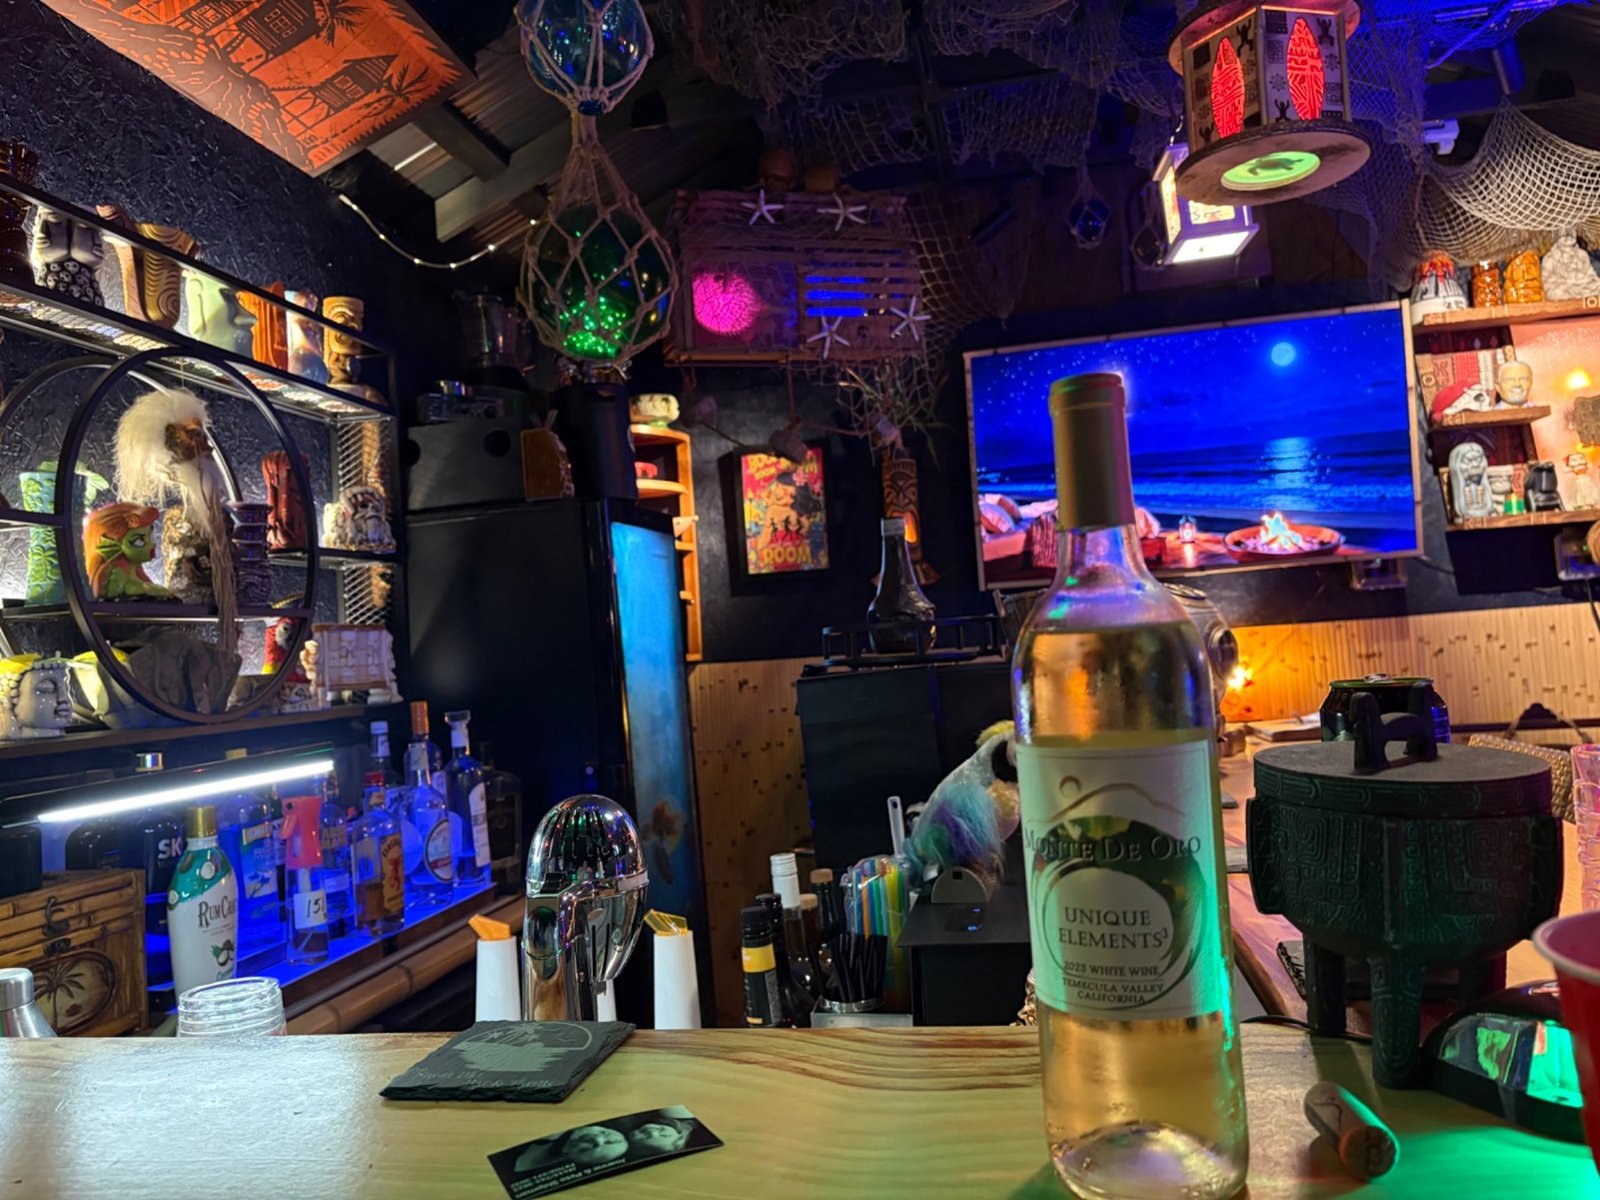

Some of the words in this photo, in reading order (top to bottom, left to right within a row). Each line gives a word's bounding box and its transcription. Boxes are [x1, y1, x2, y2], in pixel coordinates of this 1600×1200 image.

[158, 836, 182, 860] SK
[1064, 906, 1151, 927] UNIQUE
[1063, 960, 1087, 973] 2023
[1089, 964, 1126, 976] WHITE
[1128, 965, 1159, 976] WINE
[1062, 976, 1117, 993] TEMECULA
[1121, 983, 1164, 993] VALLEY
[1077, 991, 1145, 1003] CALIFORNIA
